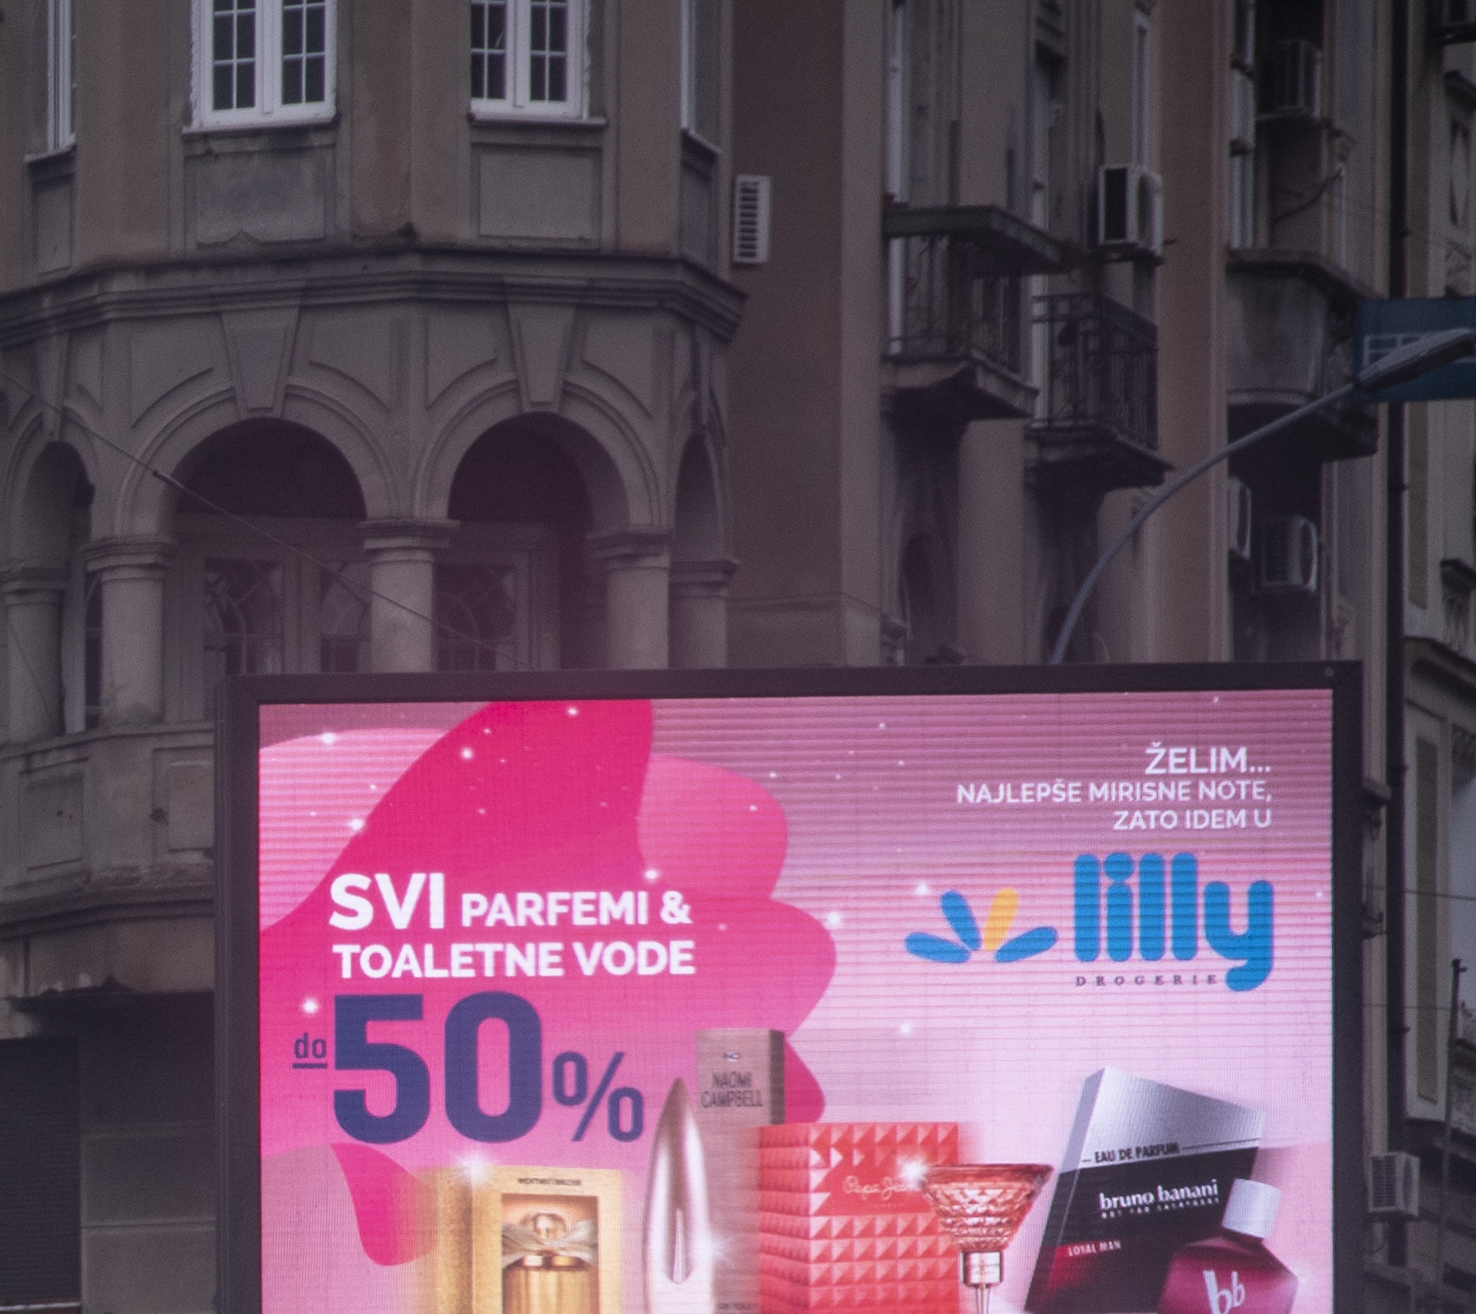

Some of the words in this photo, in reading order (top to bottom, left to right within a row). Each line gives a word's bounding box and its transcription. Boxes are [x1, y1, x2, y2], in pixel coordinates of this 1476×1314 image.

[1144, 742, 1272, 774] ŽELIM...
[957, 779, 1081, 804] NAJLEPŠE
[1088, 781, 1191, 802] MIRISNE
[1198, 779, 1273, 802] NOTE,
[1112, 811, 1178, 830] ZATO
[1185, 810, 1247, 829] IDEM
[1253, 809, 1272, 828] U
[329, 873, 445, 931] SVI
[460, 891, 648, 927] PARFEMI
[659, 890, 693, 925] &
[1072, 852, 1274, 992] lilly
[332, 943, 565, 979] TOALETNE
[572, 940, 696, 975] VODE
[1075, 974, 1217, 986] DROGERIE
[293, 1033, 327, 1060] do
[1119, 1148, 1133, 1160] DE
[1099, 1191, 1154, 1211] bruno
[1157, 1178, 1219, 1202] banani
